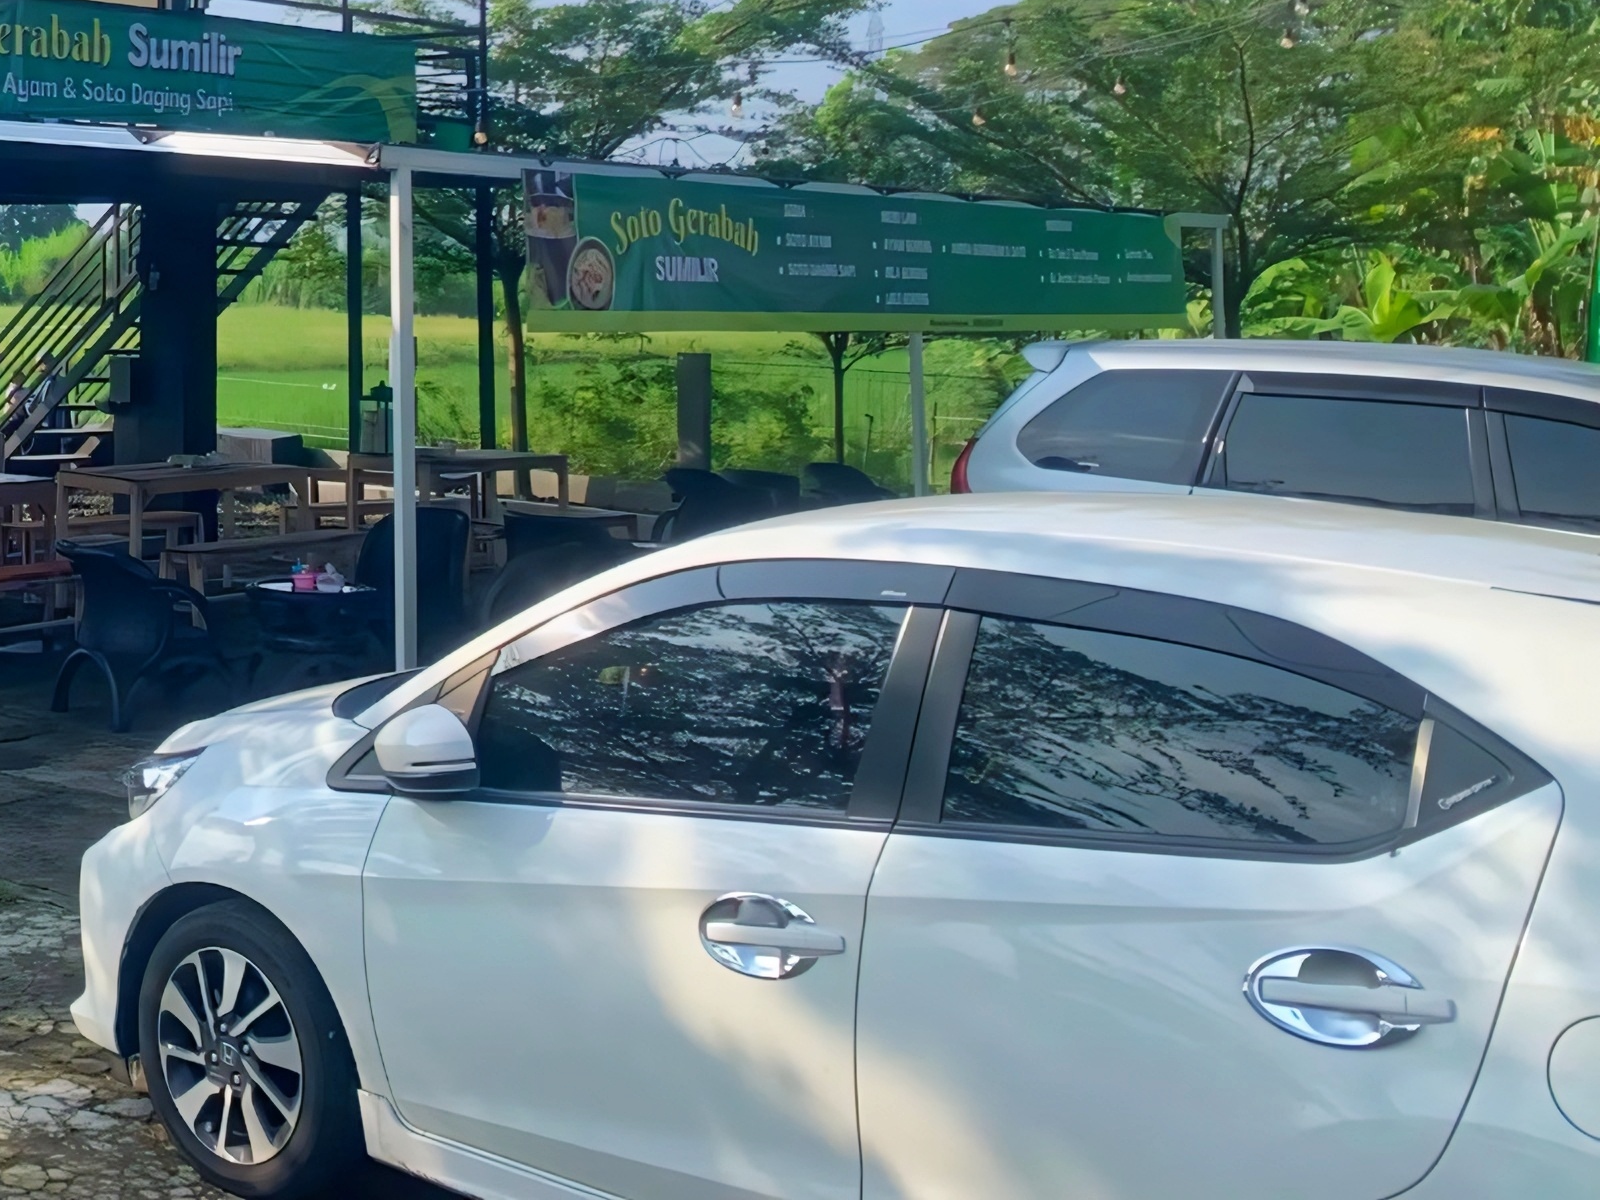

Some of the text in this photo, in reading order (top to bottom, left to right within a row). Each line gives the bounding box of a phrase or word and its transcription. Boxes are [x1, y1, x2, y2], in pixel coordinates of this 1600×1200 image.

[127, 22, 242, 75] Sumilir
[3, 72, 57, 102] Ayam
[63, 76, 76, 99] &
[82, 78, 126, 103] Soto
[132, 83, 191, 115] Daging
[196, 89, 234, 116] Sapi
[611, 197, 759, 256] Soto Gerabah
